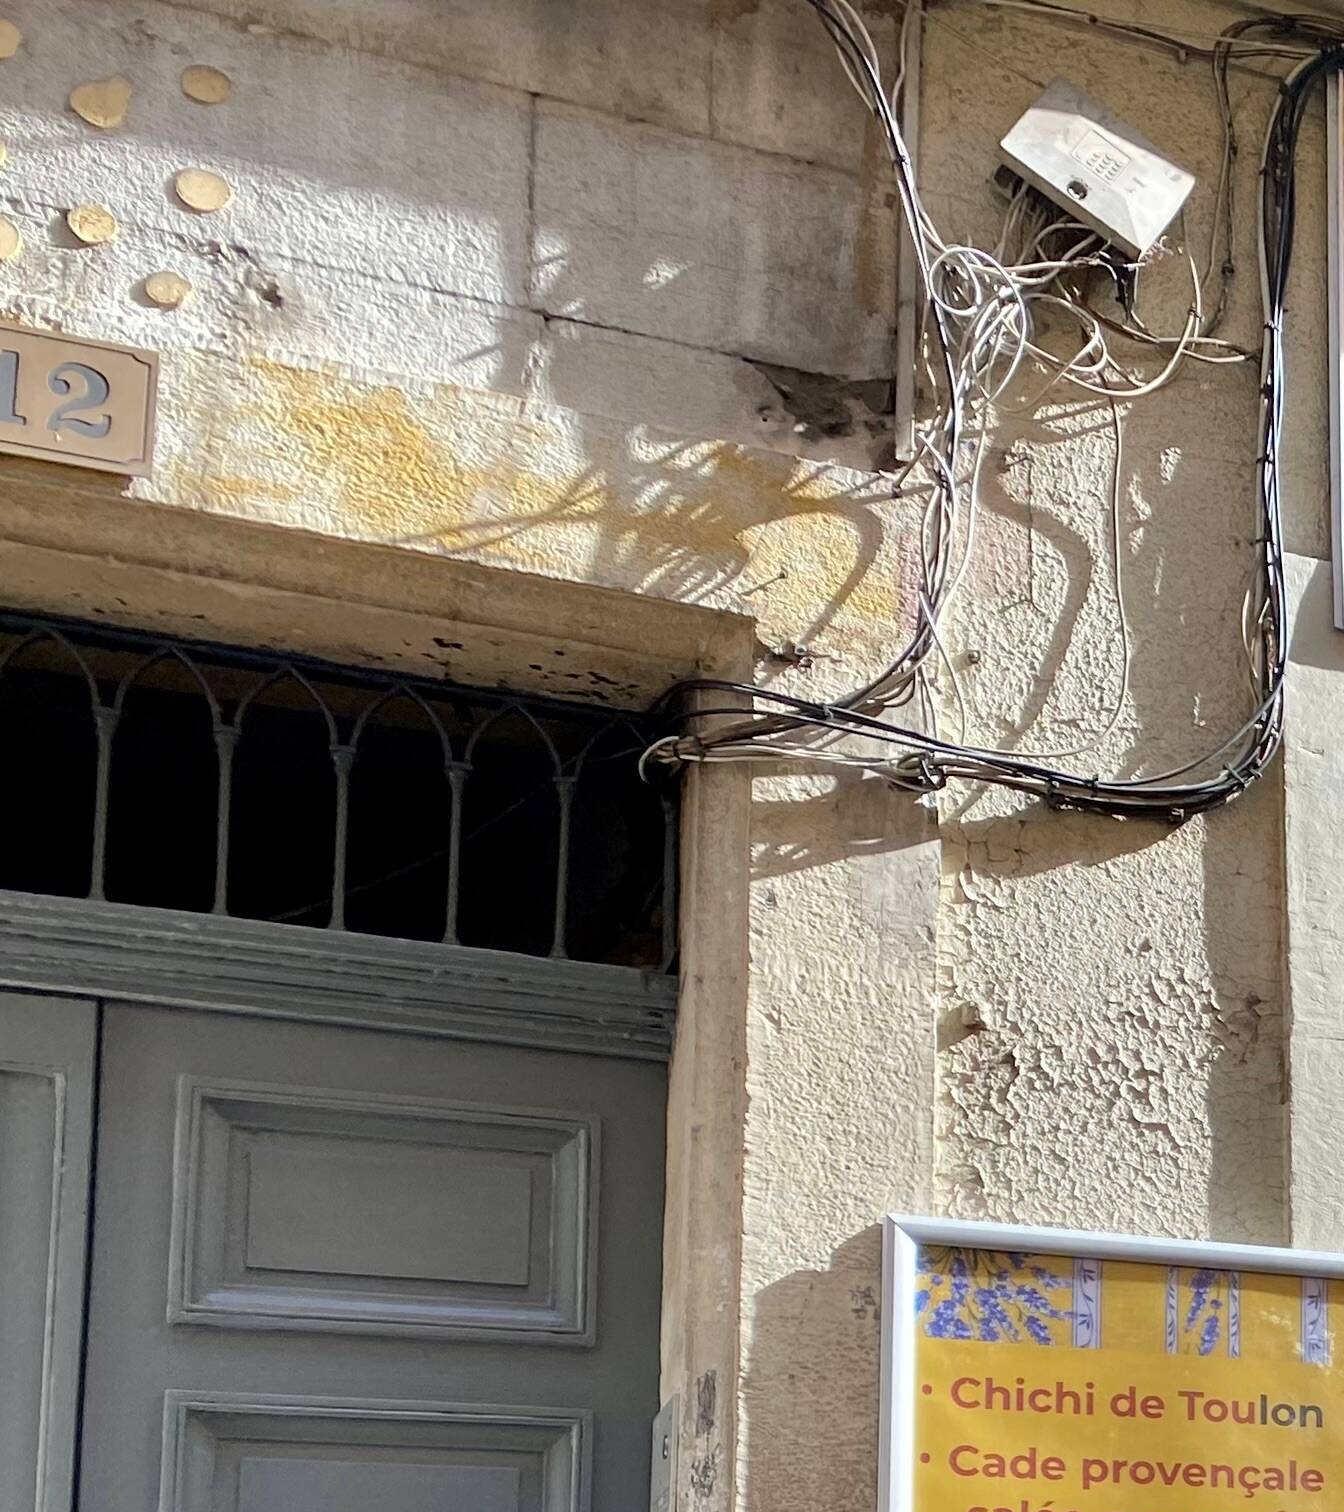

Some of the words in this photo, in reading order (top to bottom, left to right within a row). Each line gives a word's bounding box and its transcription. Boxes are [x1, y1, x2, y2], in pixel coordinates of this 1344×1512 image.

[0, 349, 112, 439] 12
[951, 1378, 1094, 1415] Chichi
[1111, 1387, 1164, 1418] de
[1178, 1391, 1322, 1427] Toulon
[949, 1445, 1066, 1480] Cade
[1083, 1459, 1324, 1498] provençale
